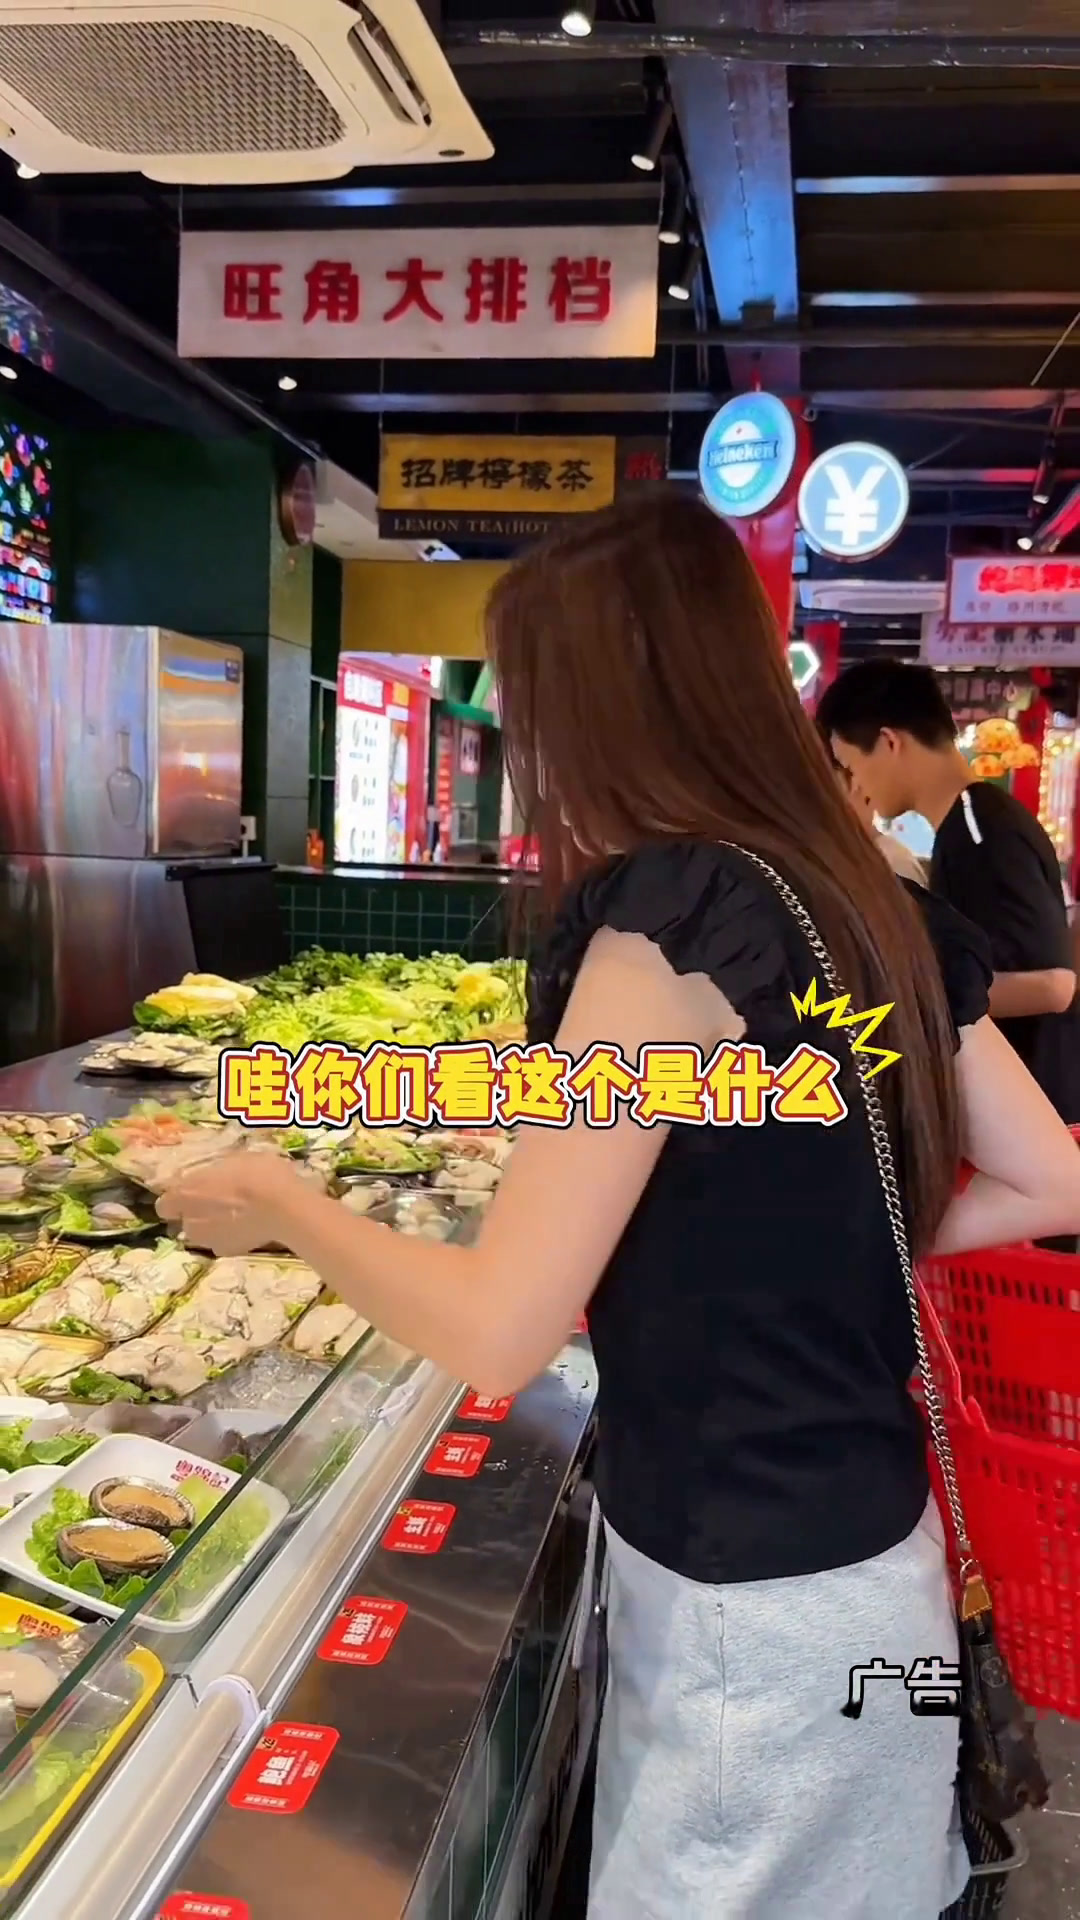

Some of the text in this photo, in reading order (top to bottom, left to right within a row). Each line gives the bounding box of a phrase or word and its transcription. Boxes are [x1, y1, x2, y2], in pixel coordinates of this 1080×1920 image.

[223, 256, 612, 324] 旺角大排档
[708, 443, 776, 467] Heineken
[400, 457, 595, 492] 招牌檸檬茶
[393, 518, 459, 533] LEMON
